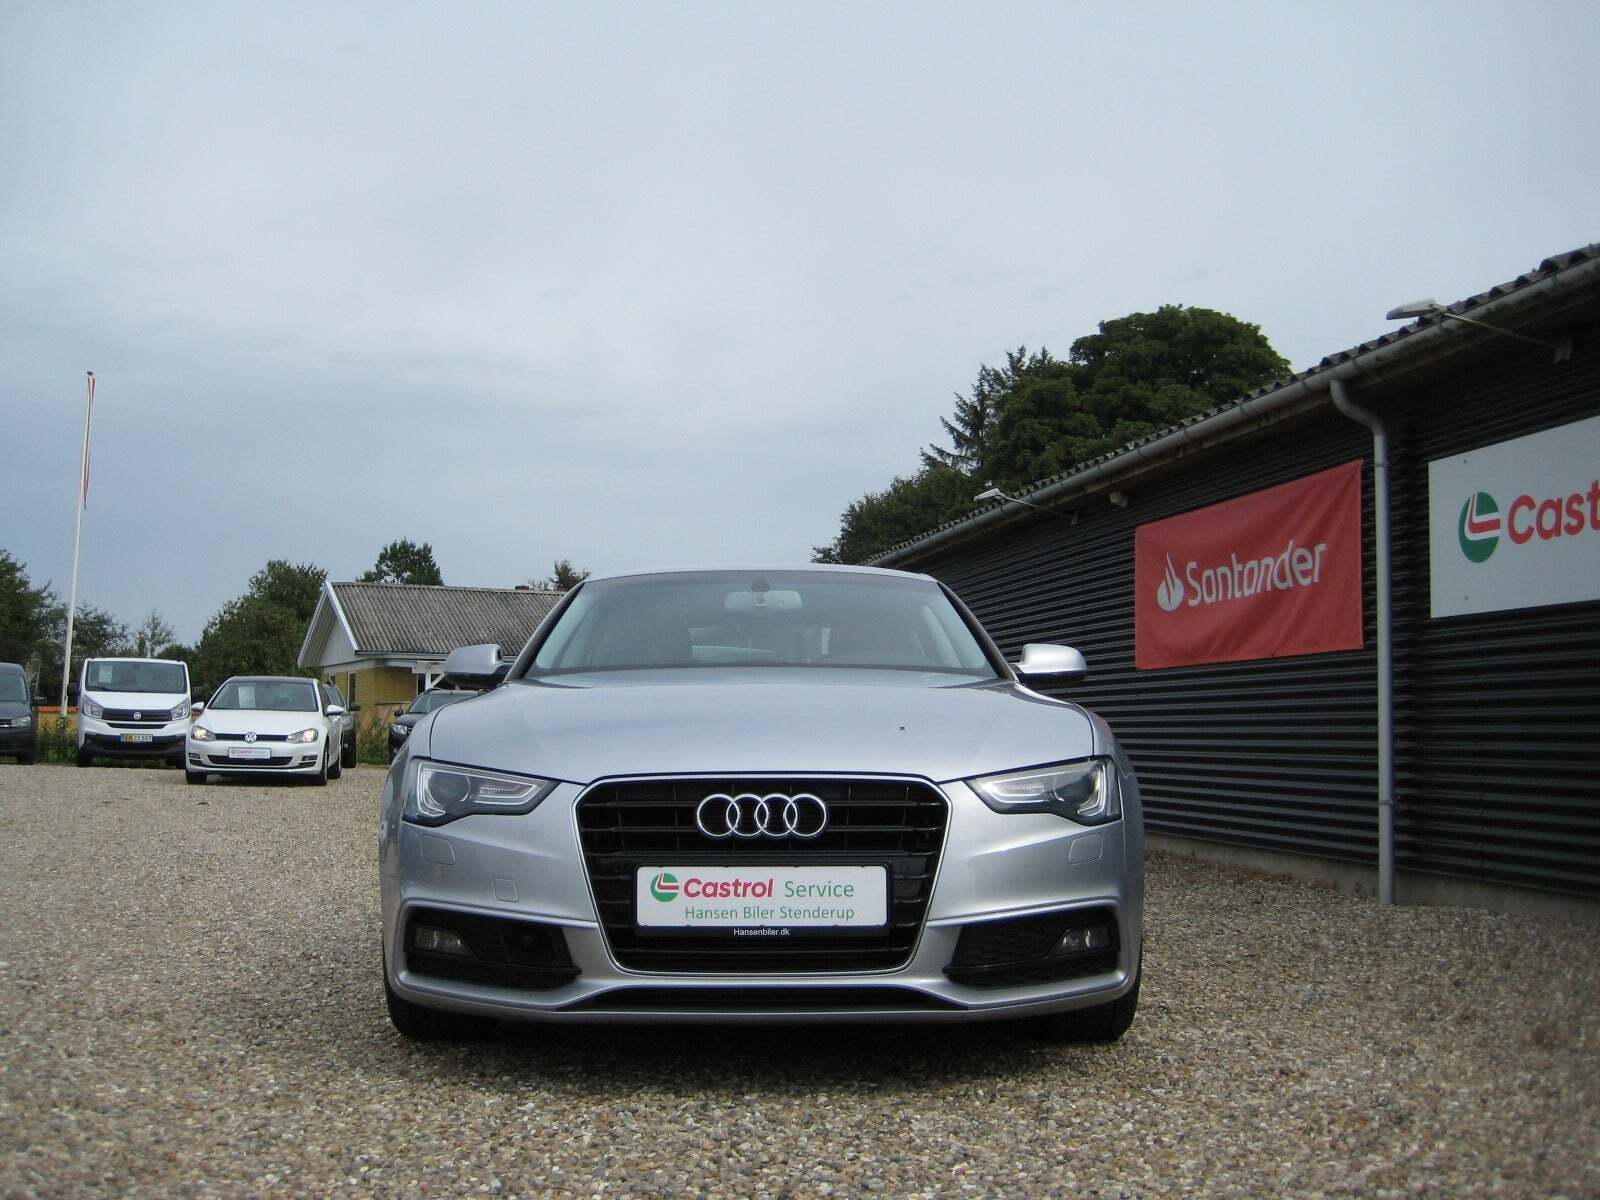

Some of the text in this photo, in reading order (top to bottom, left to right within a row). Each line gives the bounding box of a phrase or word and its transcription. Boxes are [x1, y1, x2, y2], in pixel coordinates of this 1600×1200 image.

[1507, 479, 1600, 545] Cast
[1186, 540, 1326, 606] Santander
[683, 878, 855, 898] Castrol Service
[685, 906, 855, 921] Hansen Biler Stenderup
[733, 928, 790, 936] Hansenbiler.dk
